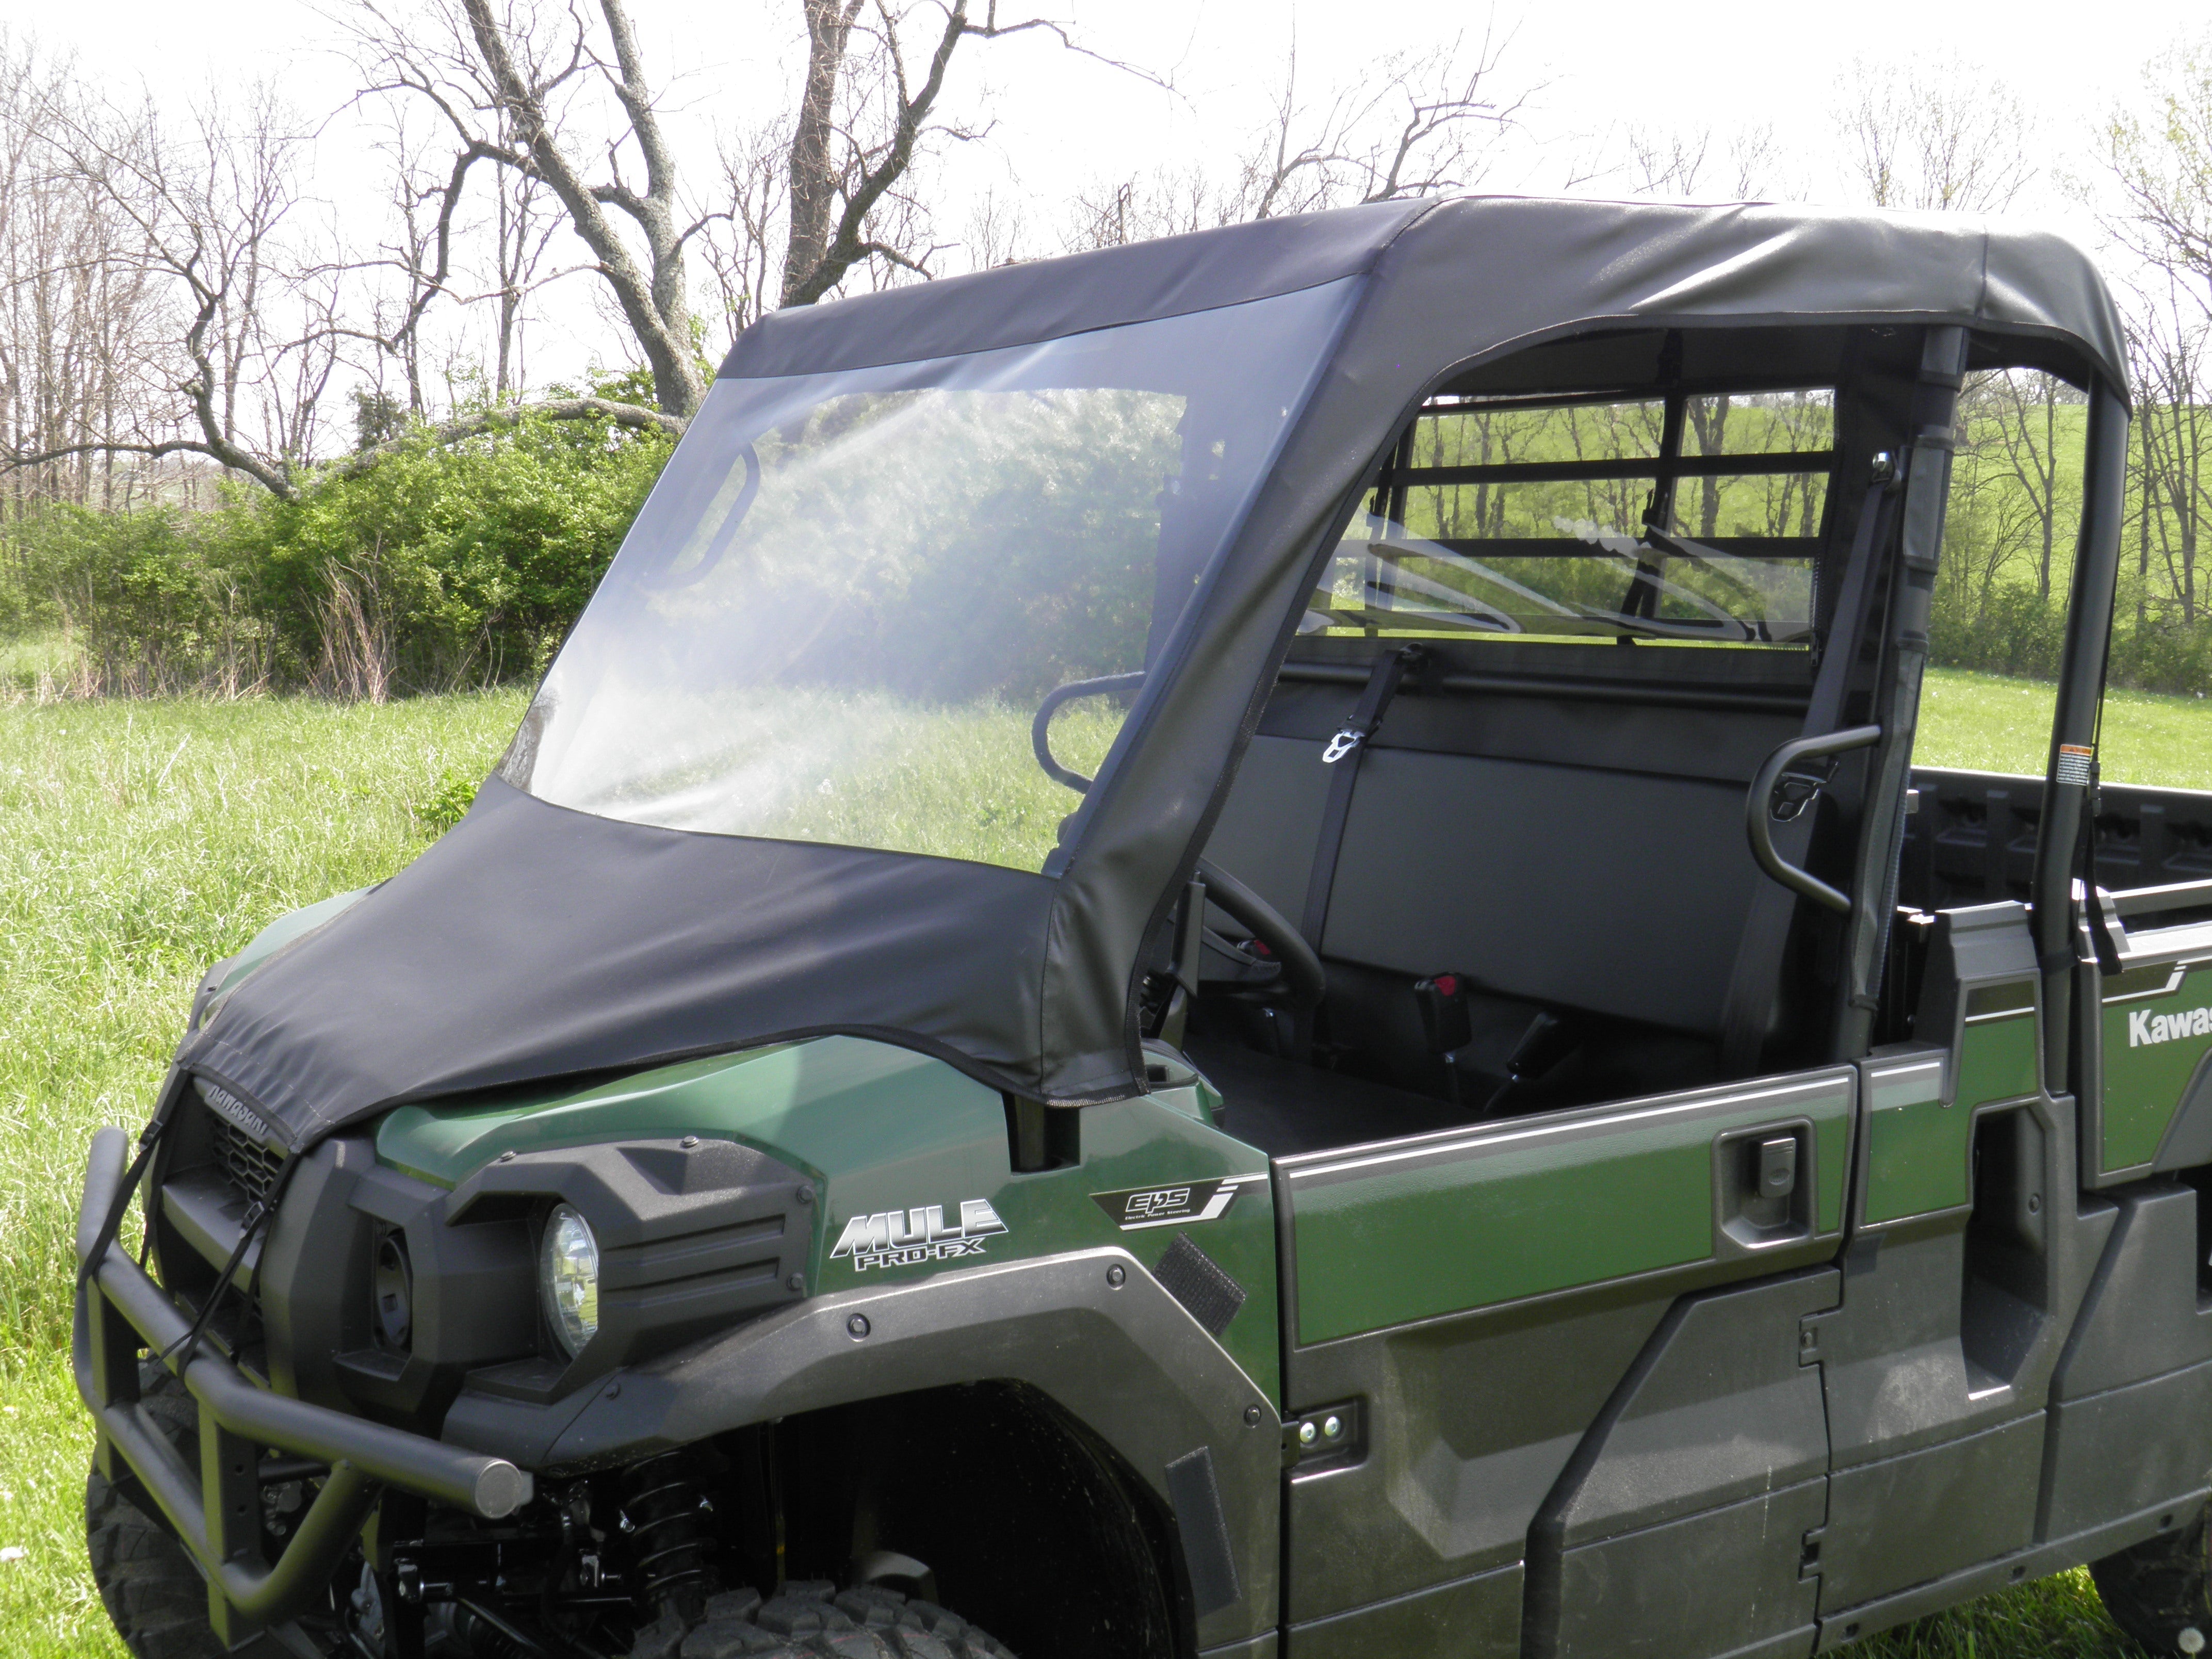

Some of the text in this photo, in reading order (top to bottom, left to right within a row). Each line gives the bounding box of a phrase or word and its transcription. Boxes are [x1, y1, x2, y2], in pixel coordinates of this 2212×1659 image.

[2129, 1007, 2211, 1047] Kawa
[829, 1198, 1009, 1259] MULE
[854, 1237, 987, 1272] PRO-FX
